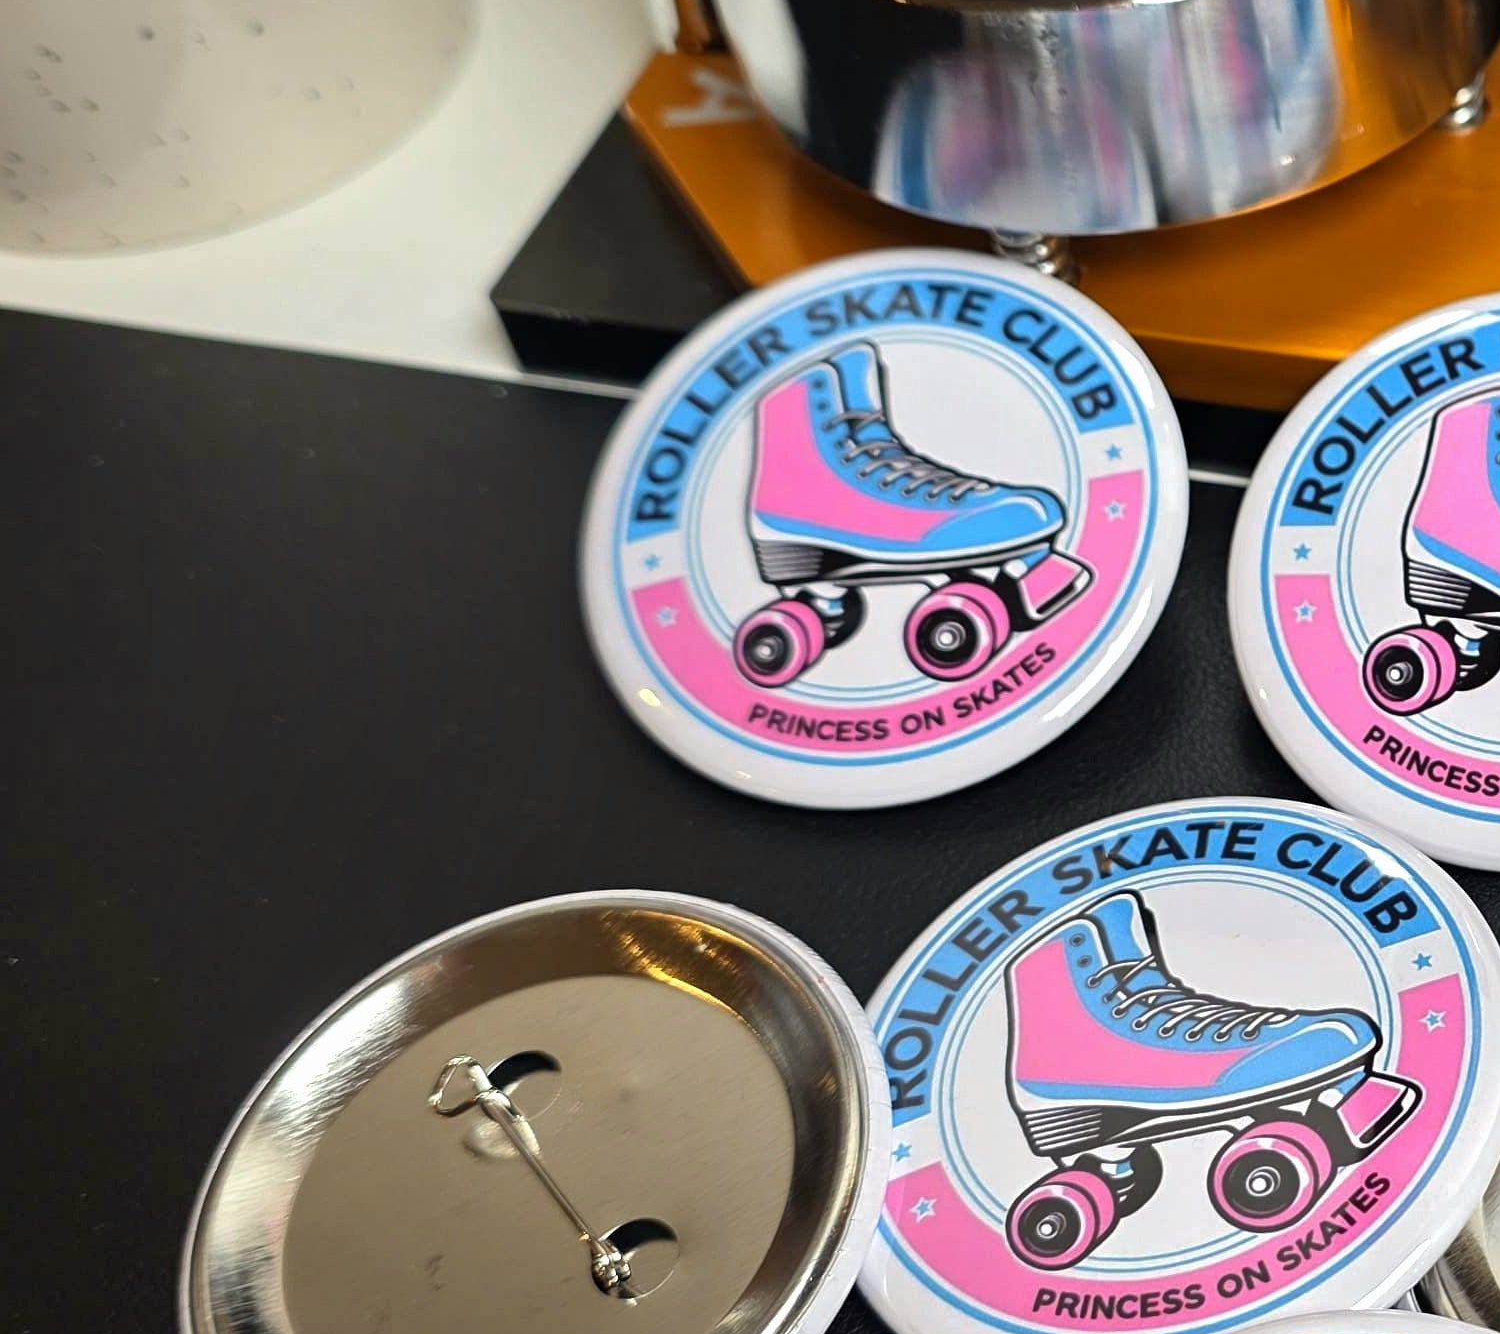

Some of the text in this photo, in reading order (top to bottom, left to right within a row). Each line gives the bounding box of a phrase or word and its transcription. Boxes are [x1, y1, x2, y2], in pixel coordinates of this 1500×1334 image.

[634, 282, 1118, 523] ROLLER SKATE CLUB
[1290, 337, 1486, 517] ROLLER
[747, 641, 1060, 744] PRINCESS ON SKATES
[885, 820, 1422, 1113] ROLLER SKATE CLUB
[1030, 1171, 1394, 1322] PRINCESS ON SKATES
